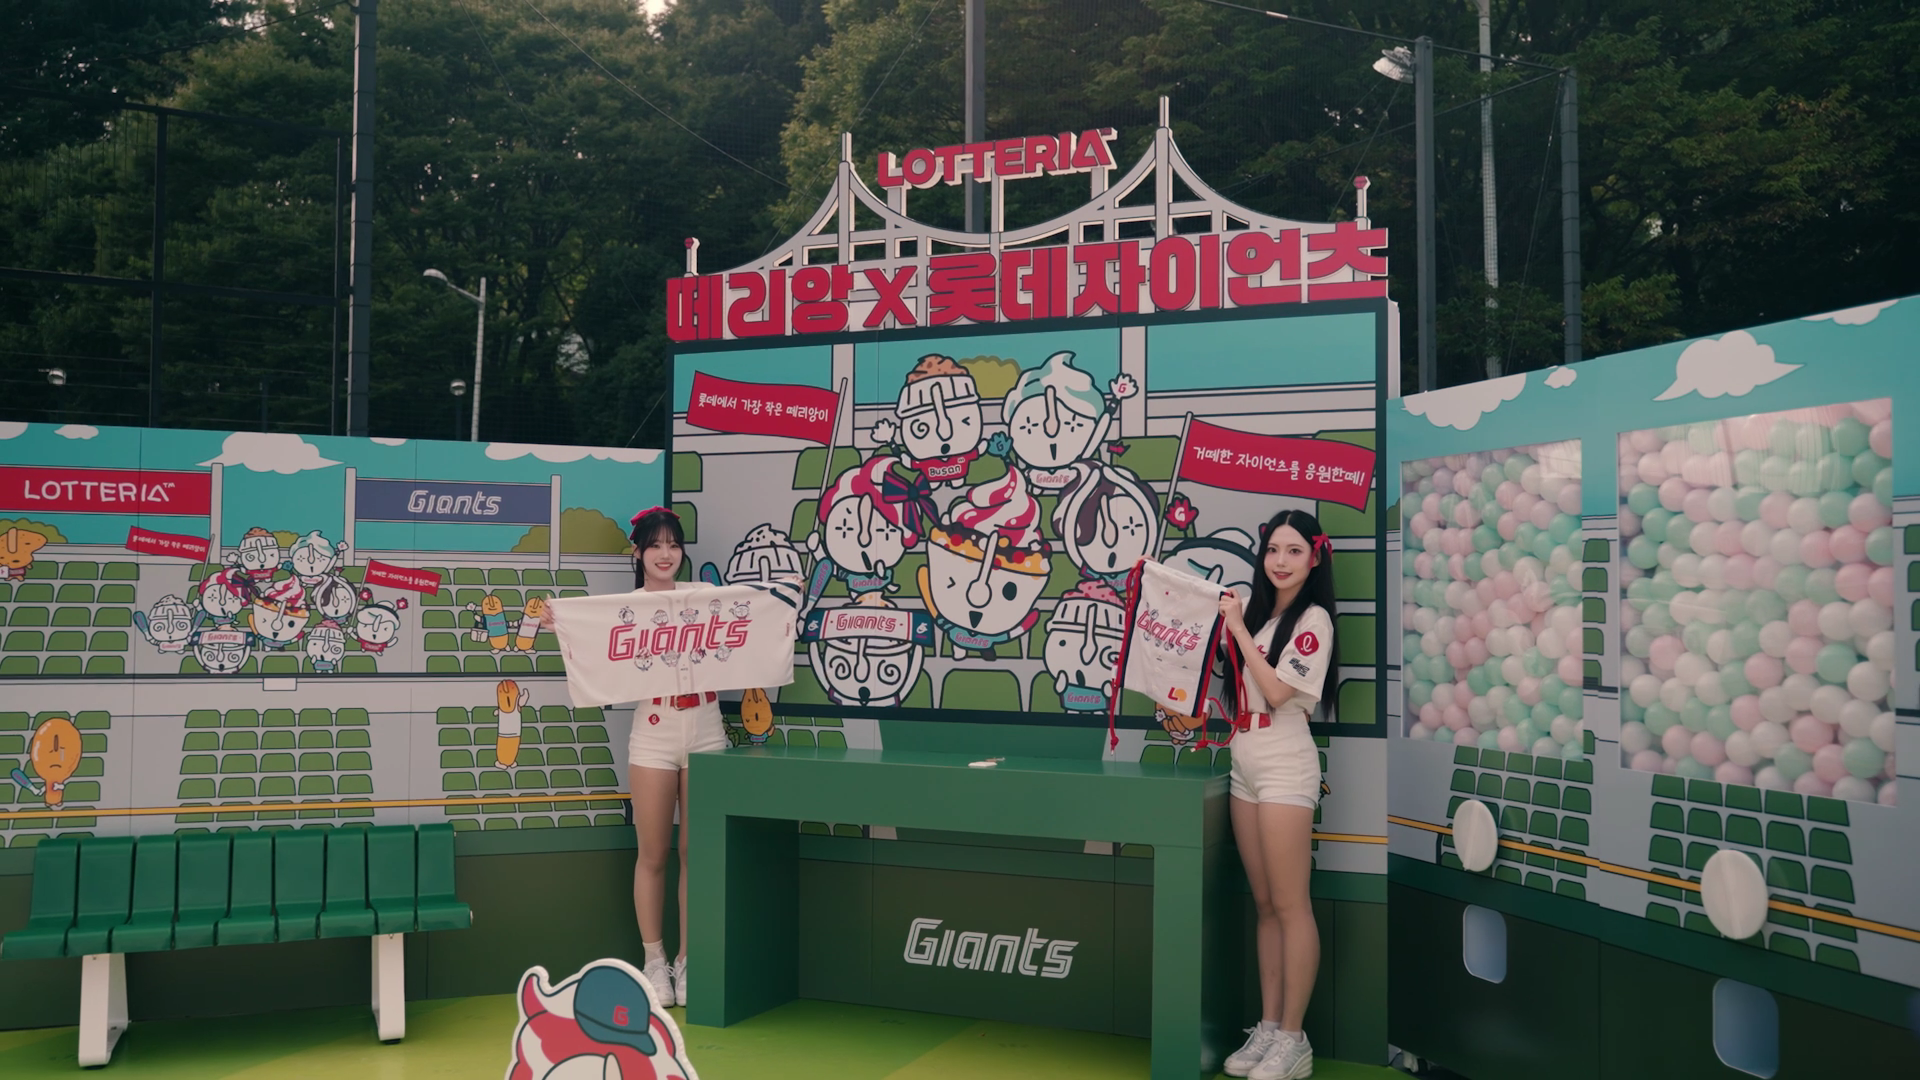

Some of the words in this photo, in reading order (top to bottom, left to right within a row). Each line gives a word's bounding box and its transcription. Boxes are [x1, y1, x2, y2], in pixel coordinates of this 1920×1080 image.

[877, 128, 1112, 187] LOTTERIA
[666, 264, 854, 341] 떼리앙
[928, 221, 1388, 326] 롯데자이언츠
[698, 392, 737, 410] 롯데에서
[741, 398, 762, 415] 가장
[764, 401, 783, 416] 작은
[785, 405, 829, 423] 떼리앙이
[929, 464, 962, 477] Busan
[1035, 473, 1070, 485] Giants
[1193, 446, 1234, 464] 거떼한
[1235, 453, 1300, 481] 자이언츠를
[1305, 463, 1366, 487] 응원한떼!
[407, 489, 502, 516] Giants
[852, 577, 883, 589] Giants
[835, 613, 898, 633] Giants
[1136, 609, 1202, 651] Giants
[607, 614, 753, 662] Giants
[954, 631, 990, 649] Giants
[1066, 692, 1102, 705] Giants
[903, 917, 1080, 979] Giants
[613, 1005, 629, 1027] G
